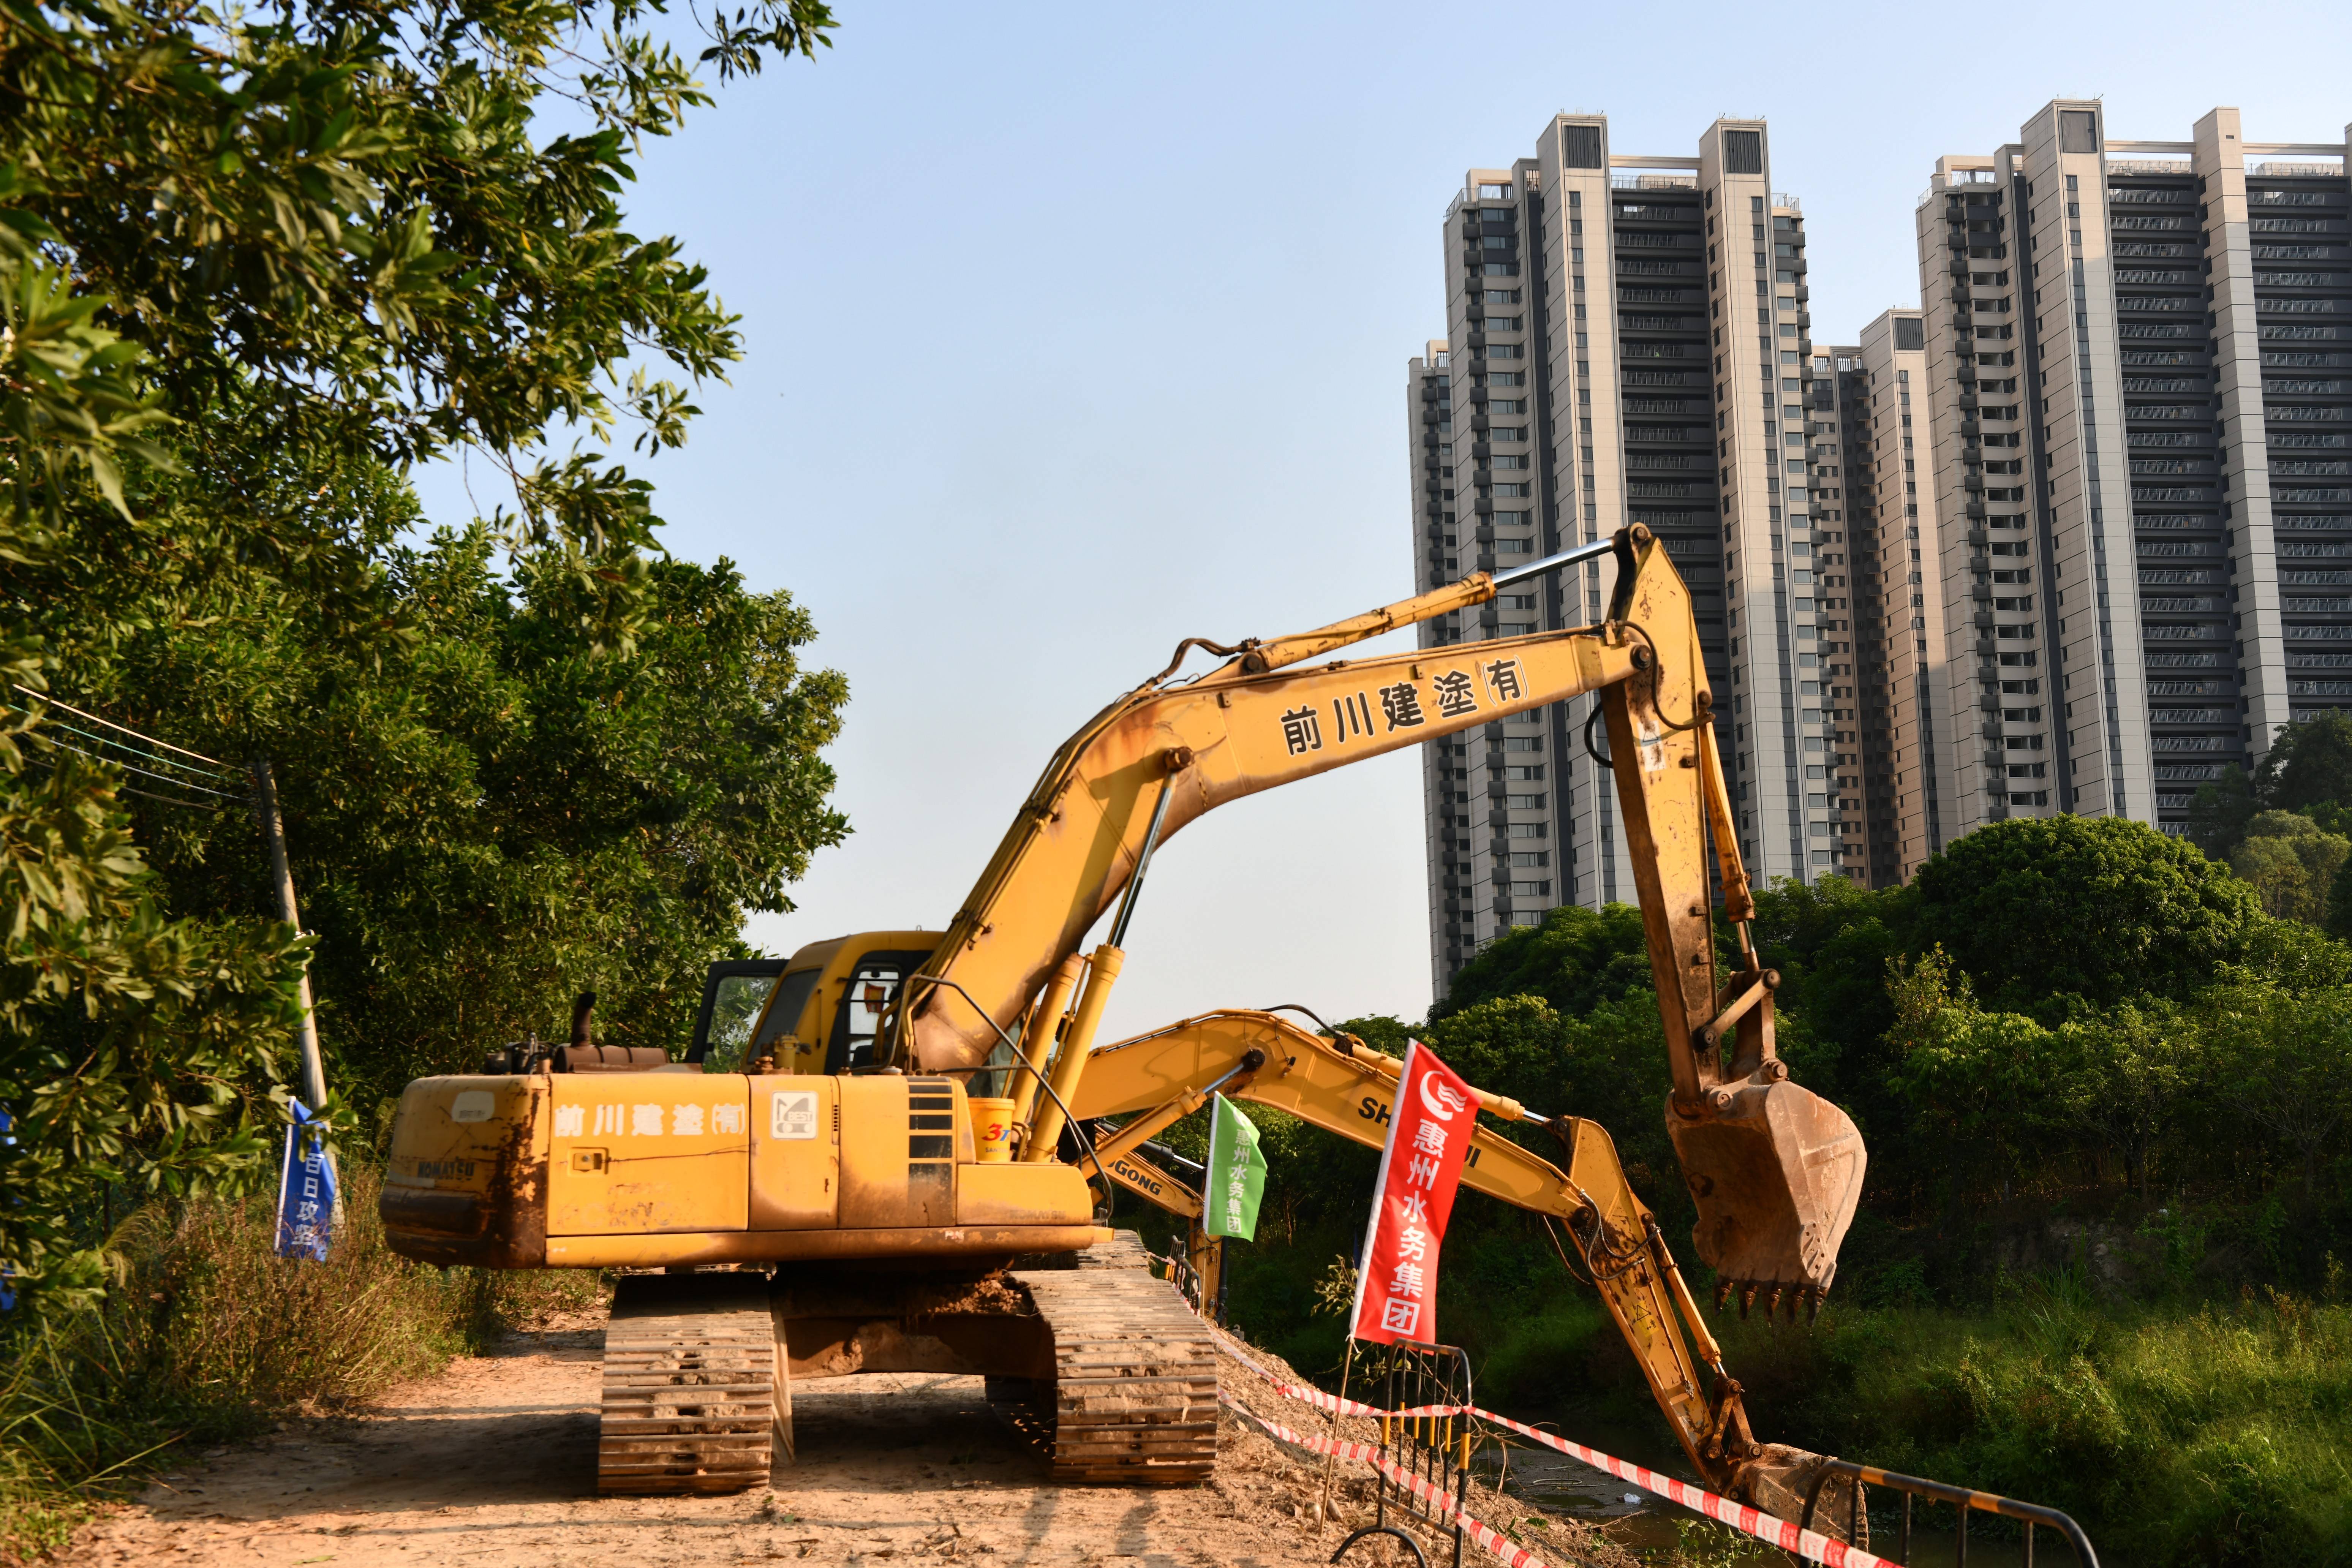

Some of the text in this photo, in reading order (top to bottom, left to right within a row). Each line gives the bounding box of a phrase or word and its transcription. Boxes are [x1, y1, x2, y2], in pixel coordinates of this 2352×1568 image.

[789, 1111, 812, 1121] BEST
[418, 1161, 475, 1181] KOMATSU
[1107, 1160, 1162, 1195] GONG
[1227, 1129, 1251, 1233] 惠州水务集团
[291, 1152, 325, 1246] 百日攻坚
[1009, 1210, 1066, 1219] KOMATSU
[1380, 1118, 1449, 1336] 惠州水务集团
